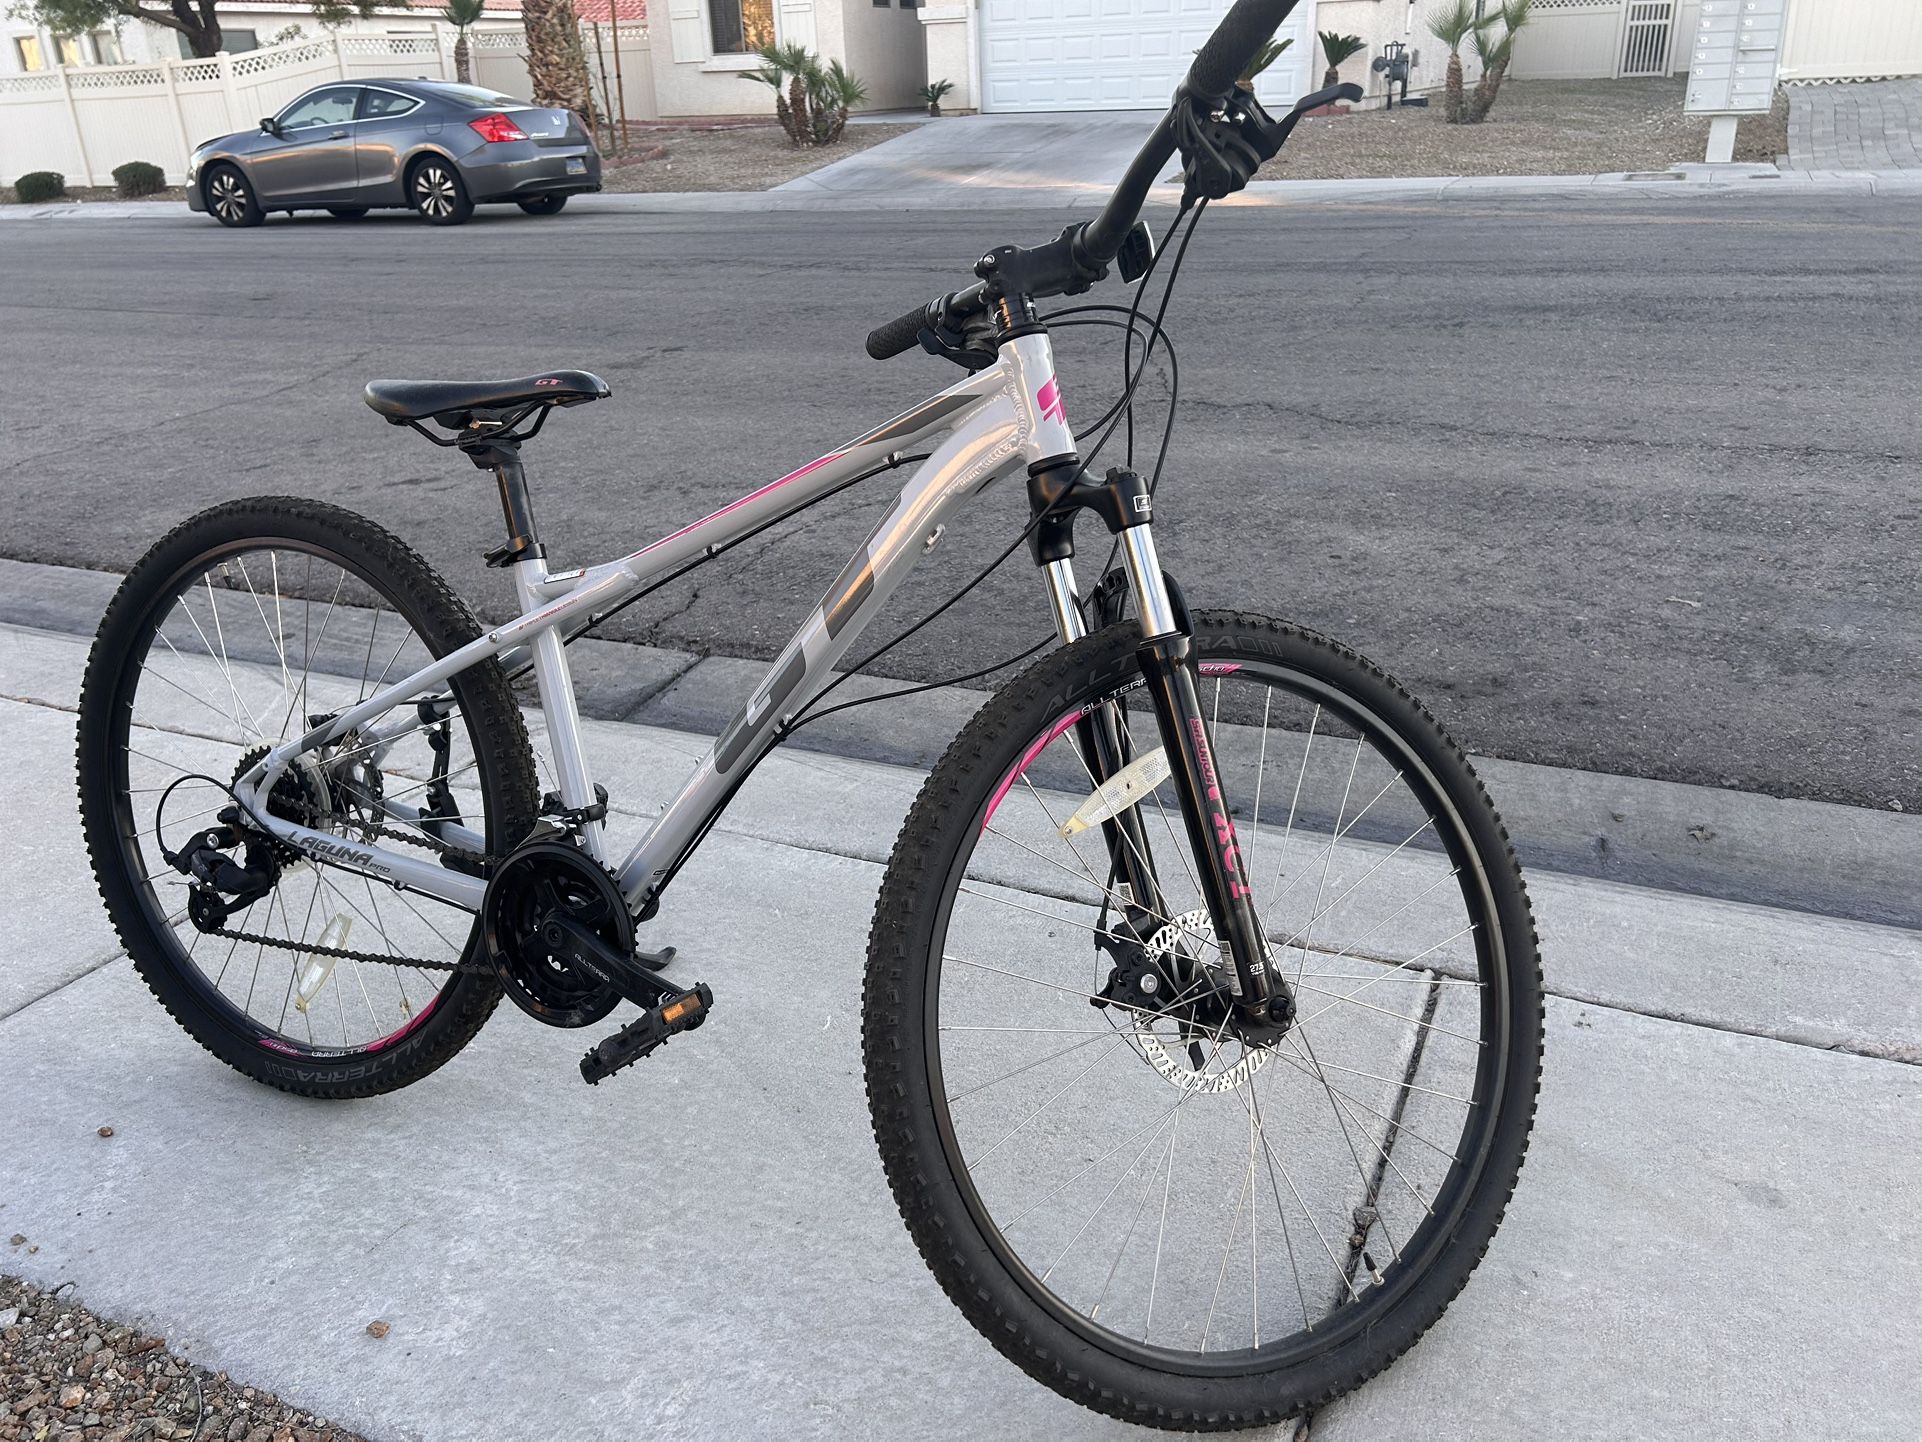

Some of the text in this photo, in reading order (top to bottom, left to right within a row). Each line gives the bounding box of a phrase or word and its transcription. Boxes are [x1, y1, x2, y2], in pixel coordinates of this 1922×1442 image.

[535, 378, 563, 386] GT
[286, 830, 391, 873] LAGUNA PRO
[299, 1062, 384, 1083] TERRA
